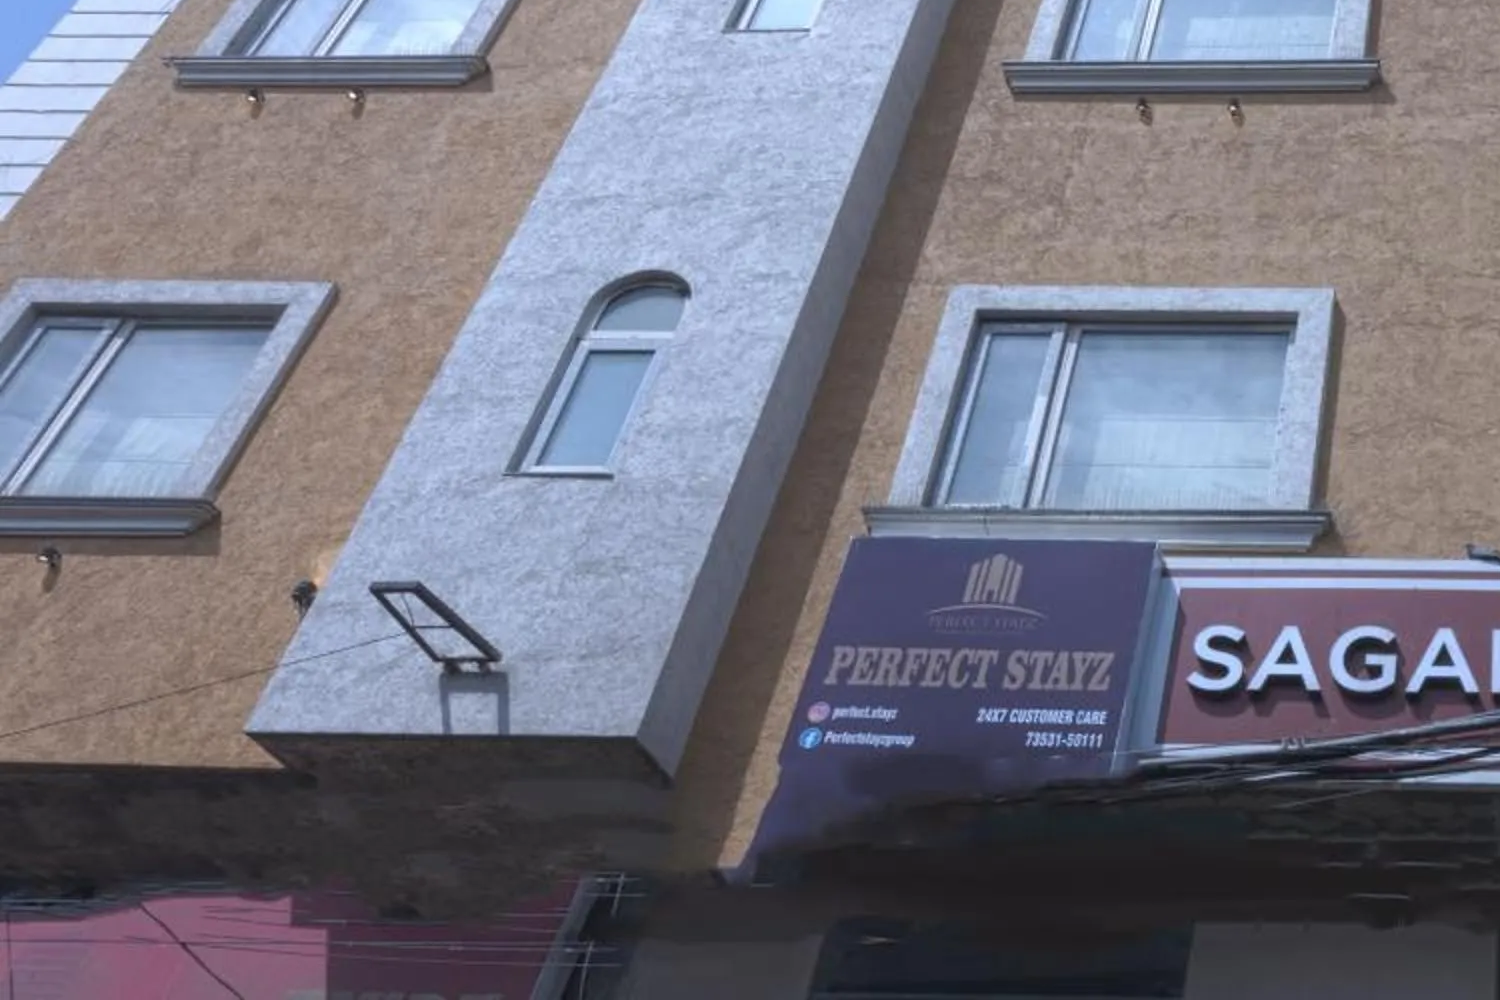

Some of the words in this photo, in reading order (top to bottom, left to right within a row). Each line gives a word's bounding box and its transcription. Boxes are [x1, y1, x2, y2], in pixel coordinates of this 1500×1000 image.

[824, 646, 998, 688] PERFECT
[1003, 650, 1114, 691] STAYZ
[1009, 709, 1075, 725] CUSTOMER
[1076, 711, 1107, 725] CARE
